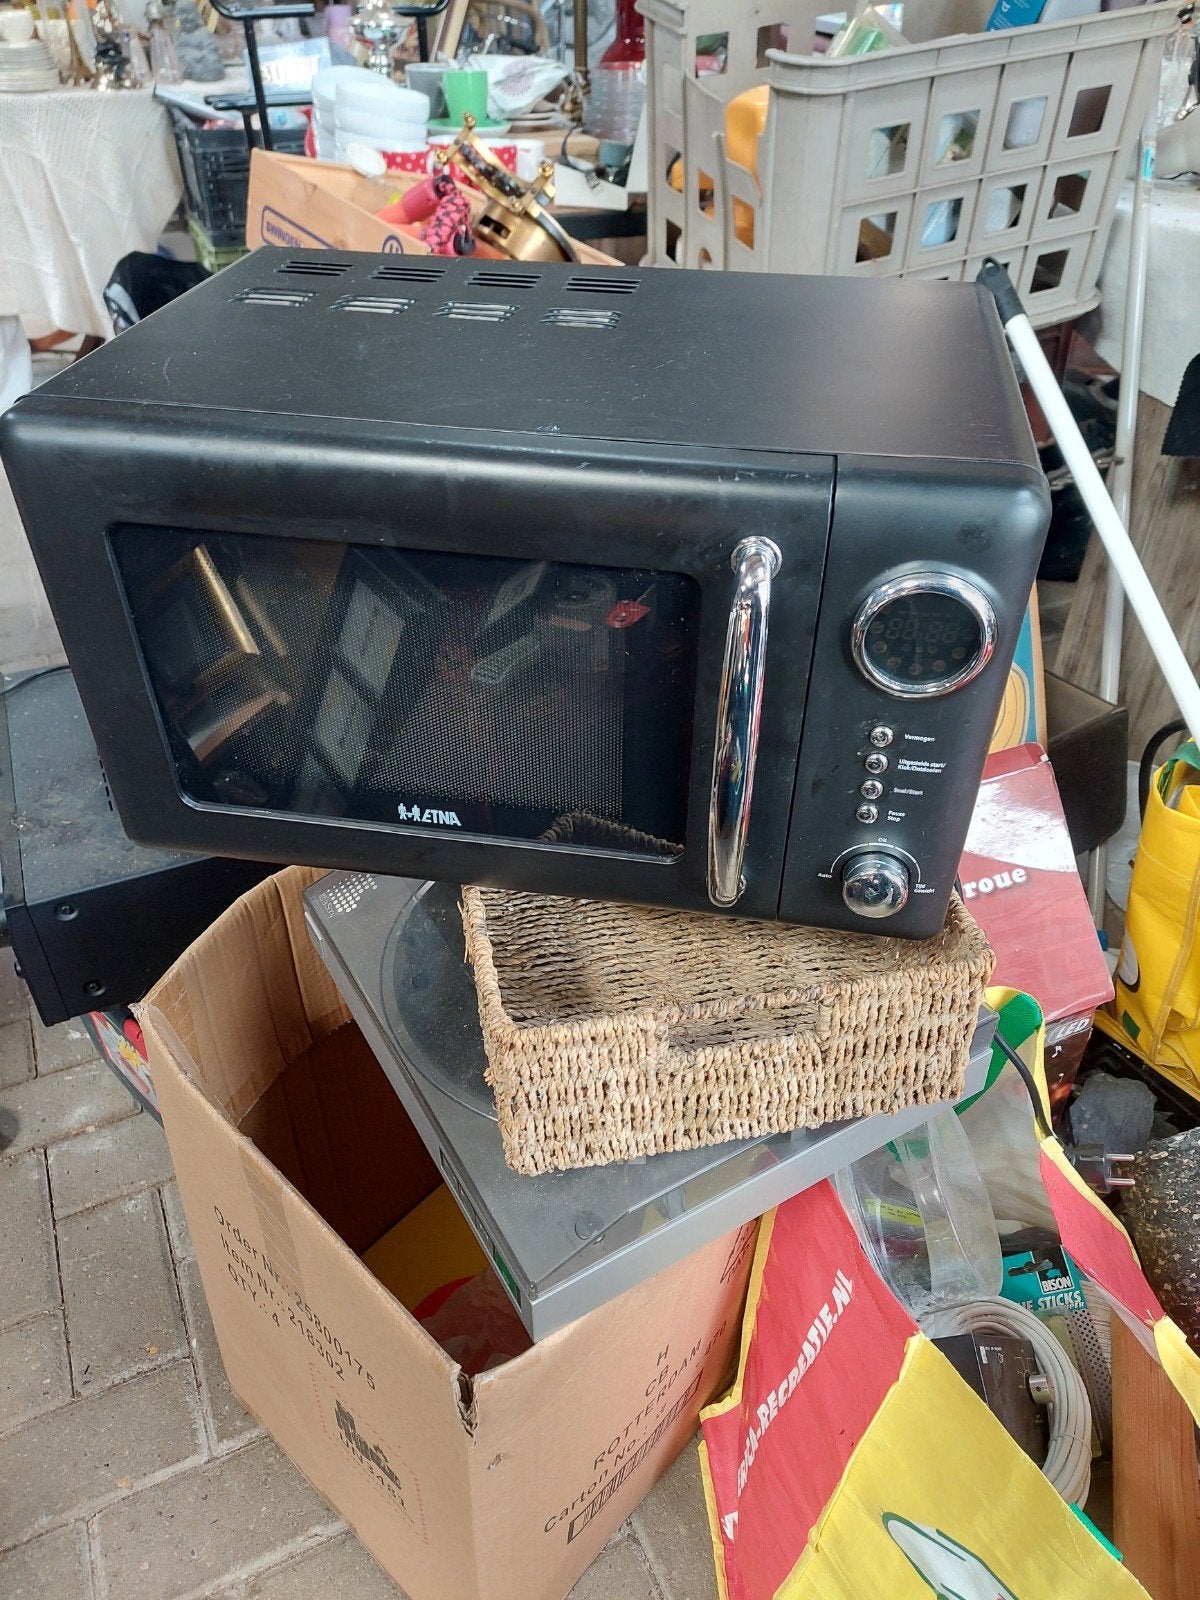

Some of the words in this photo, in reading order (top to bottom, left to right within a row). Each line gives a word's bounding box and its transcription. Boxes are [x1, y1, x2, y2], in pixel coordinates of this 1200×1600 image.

[421, 808, 462, 827] ETNA
[1054, 1017, 1091, 1040] LED
[213, 1204, 258, 1260] Order
[220, 1232, 254, 1279] Item
[1037, 1290, 1082, 1310] STICKS
[1041, 1275, 1073, 1293] BISON
[593, 1338, 702, 1471] ROTTERDAM
[543, 1468, 609, 1534] Carton
